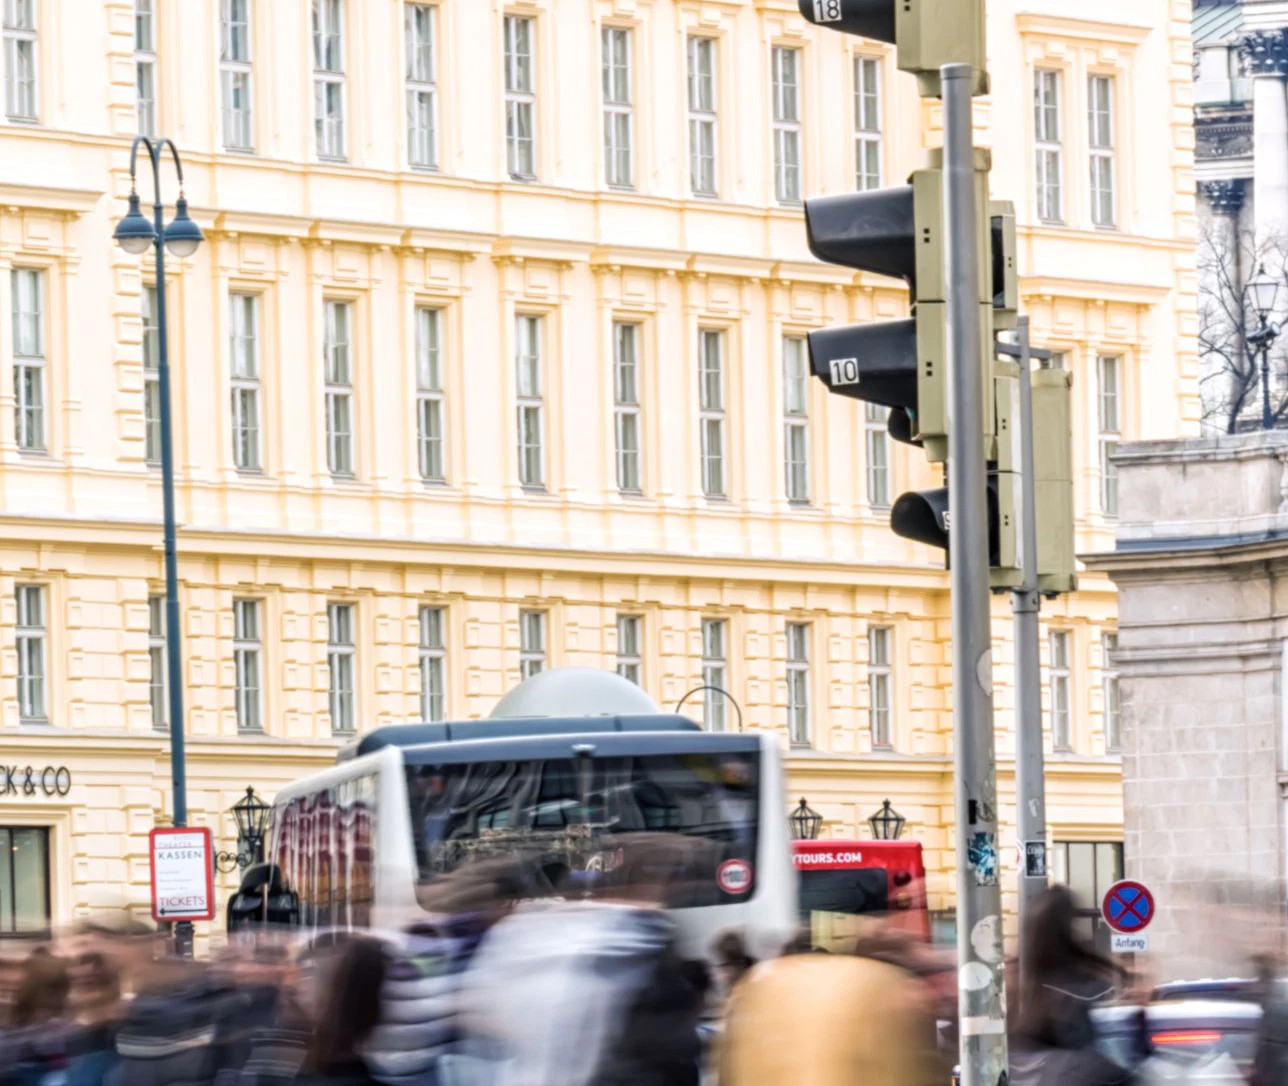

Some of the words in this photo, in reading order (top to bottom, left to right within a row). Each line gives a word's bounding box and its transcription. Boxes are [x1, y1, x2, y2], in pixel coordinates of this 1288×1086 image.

[815, 0, 839, 20] 18
[833, 360, 857, 383] 10
[23, 766, 36, 796] &
[42, 765, 72, 797] CO
[159, 850, 202, 860] KASSEN
[791, 852, 862, 864] YTOURS.COM
[159, 895, 204, 907] TICKETS
[1115, 937, 1145, 950] Anfang
